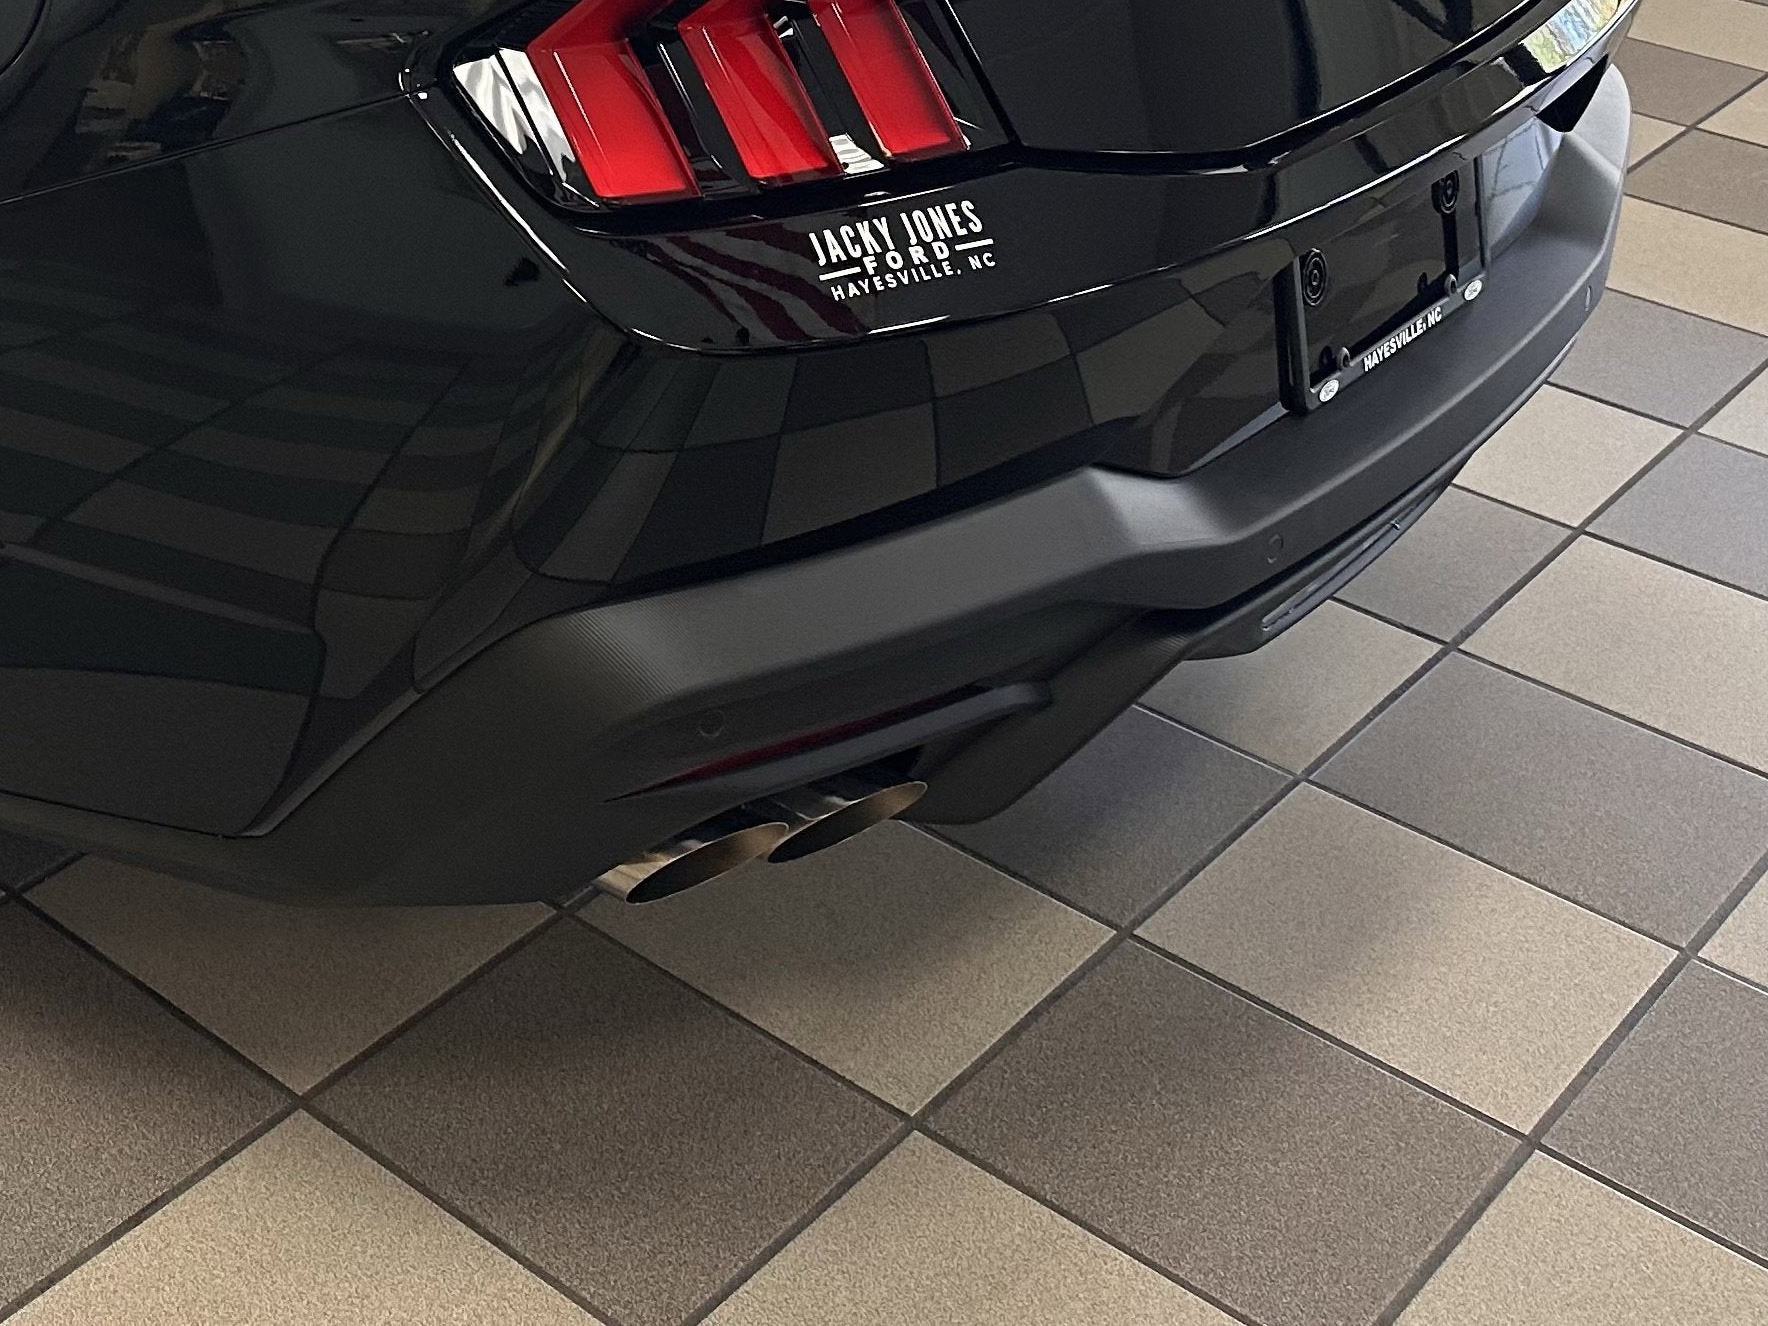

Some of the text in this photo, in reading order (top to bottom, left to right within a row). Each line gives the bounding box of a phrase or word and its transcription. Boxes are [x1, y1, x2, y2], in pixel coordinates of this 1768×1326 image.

[809, 200, 983, 267] JACKY JONES
[863, 241, 950, 275] FORD
[831, 252, 996, 301] HAYESVILLE, NC
[1363, 306, 1443, 372] HAYESVILLE, NC
